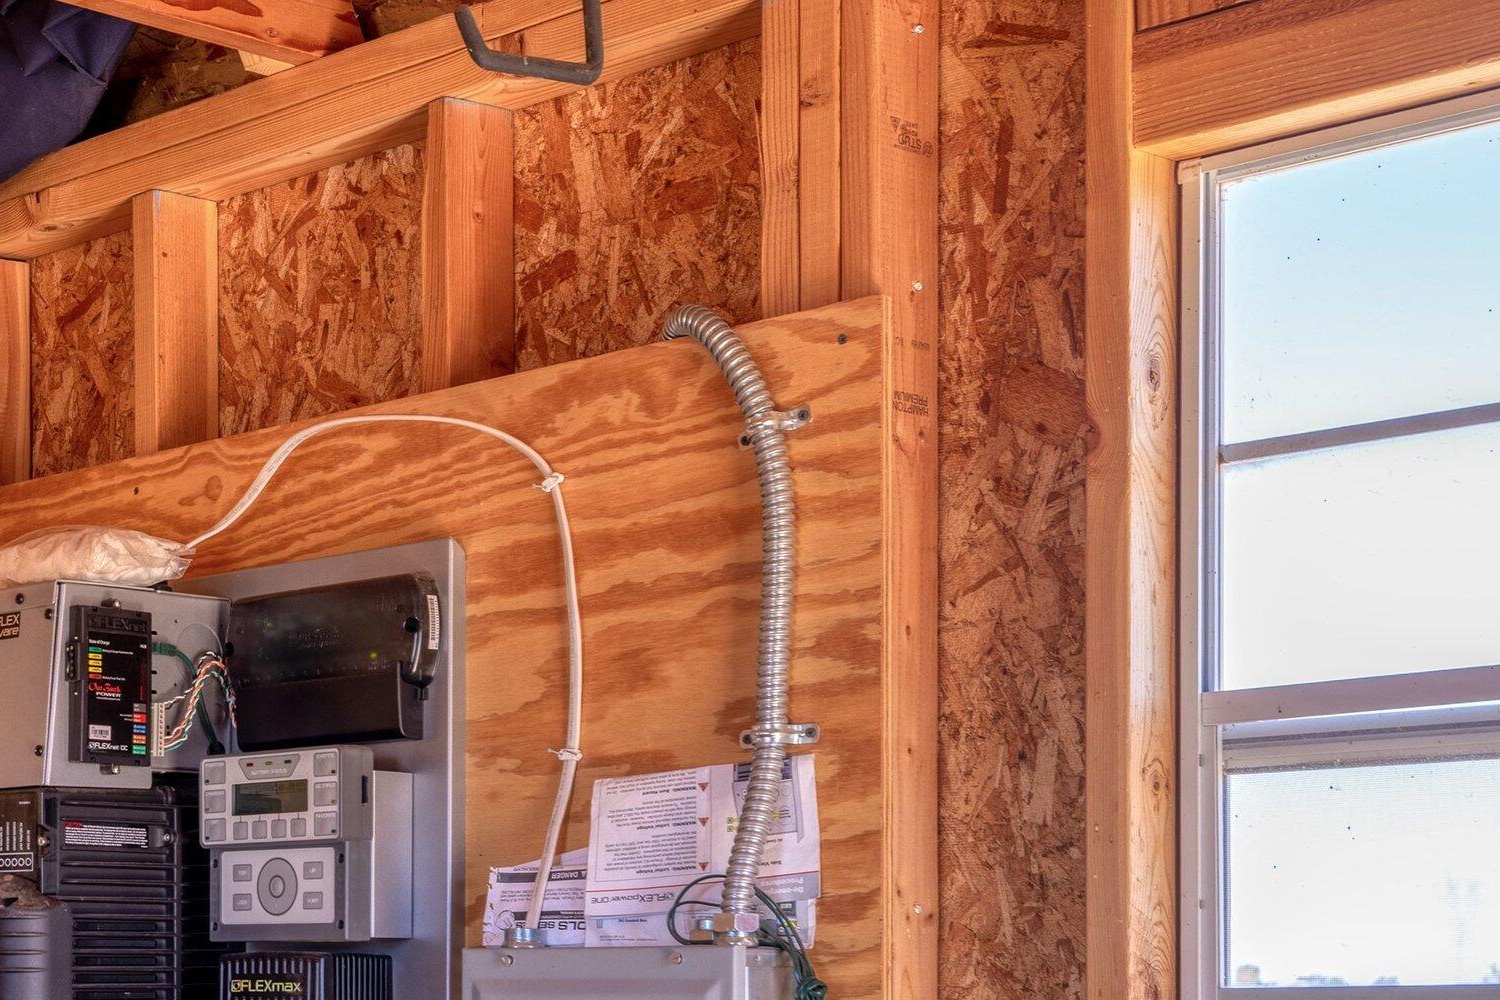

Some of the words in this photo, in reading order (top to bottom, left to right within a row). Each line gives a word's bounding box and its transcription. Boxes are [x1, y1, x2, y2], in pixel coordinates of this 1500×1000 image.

[897, 132, 922, 150] STUD
[893, 390, 928, 407] PREMIUM
[892, 400, 929, 417] HAMPTON
[551, 872, 579, 880] DANGER
[240, 980, 301, 992] FLEXmax
